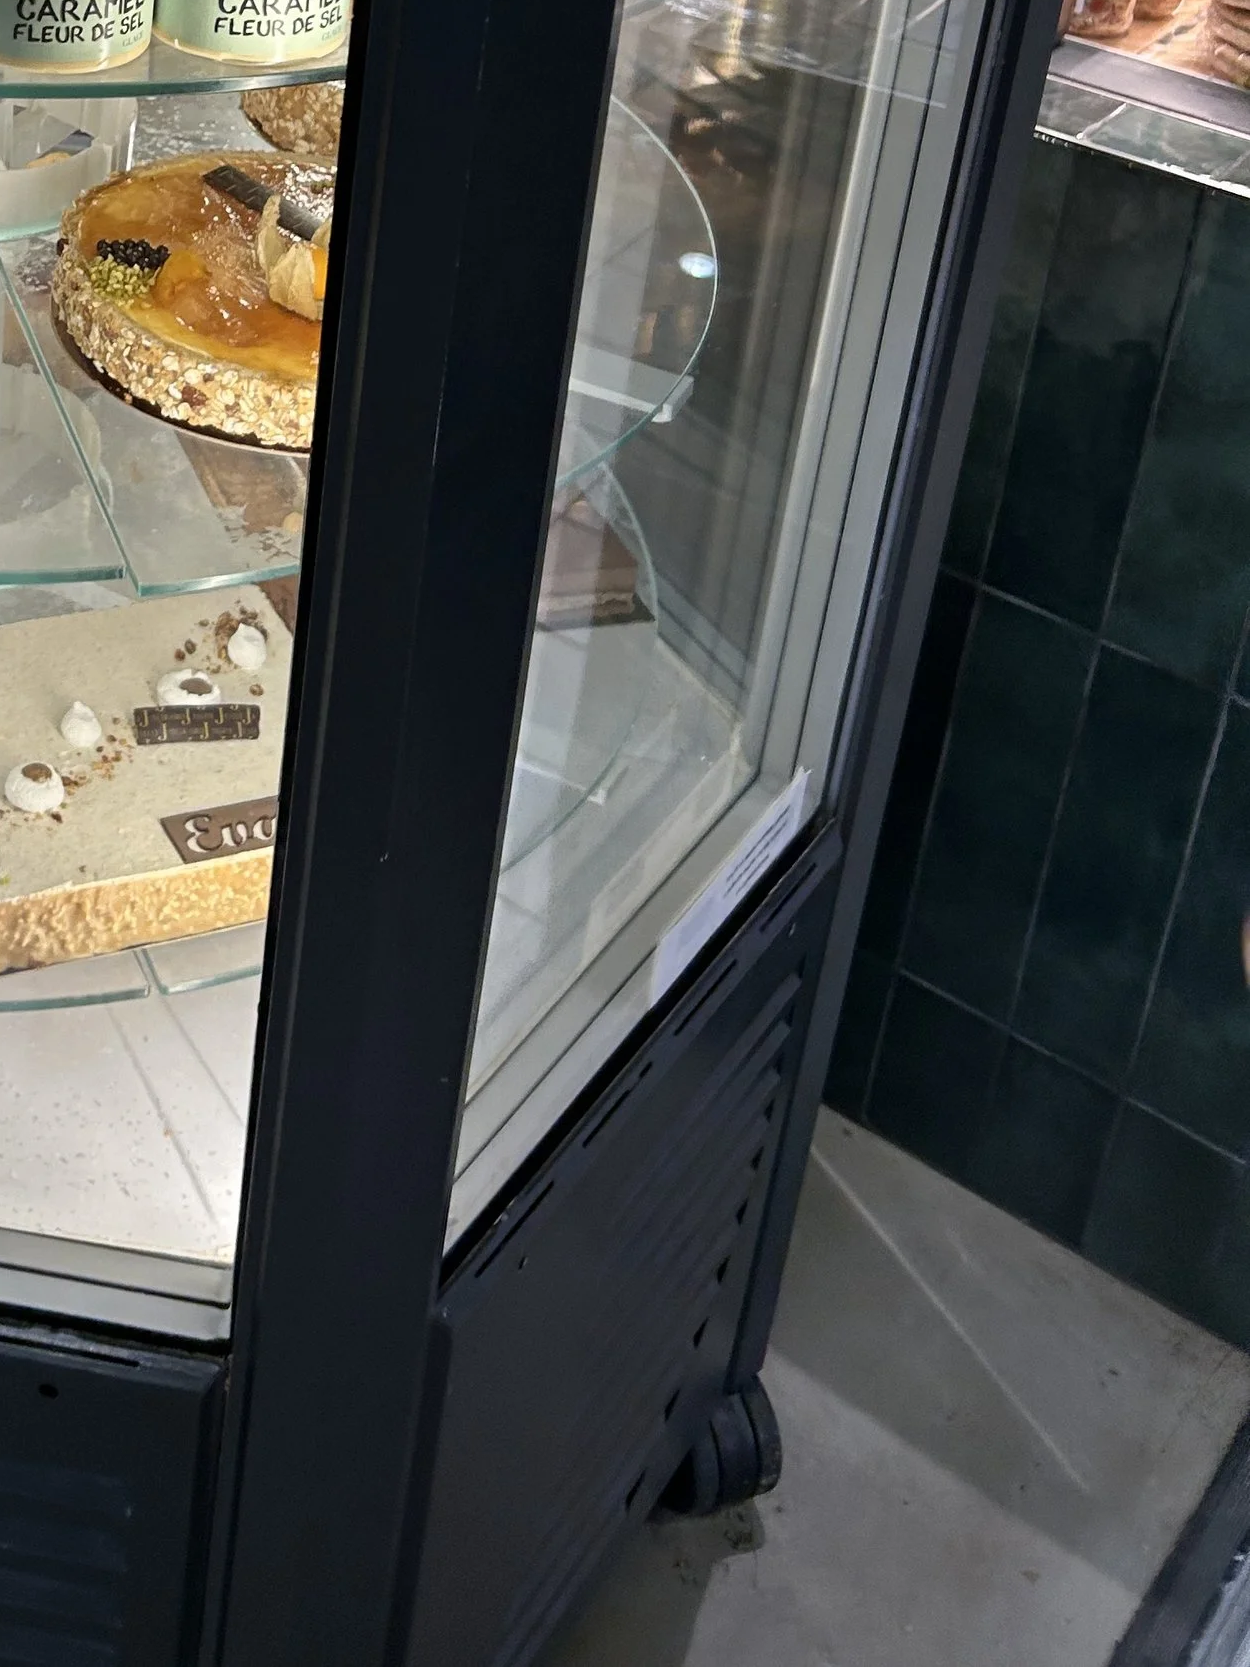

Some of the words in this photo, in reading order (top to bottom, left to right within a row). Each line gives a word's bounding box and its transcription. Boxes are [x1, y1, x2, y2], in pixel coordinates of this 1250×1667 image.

[12, 23, 85, 44] FLEUR
[91, 20, 116, 42] DE
[119, 12, 144, 36] SEL
[214, 16, 286, 37] FLEUR
[292, 14, 316, 35] DE
[319, 5, 343, 29] SEL
